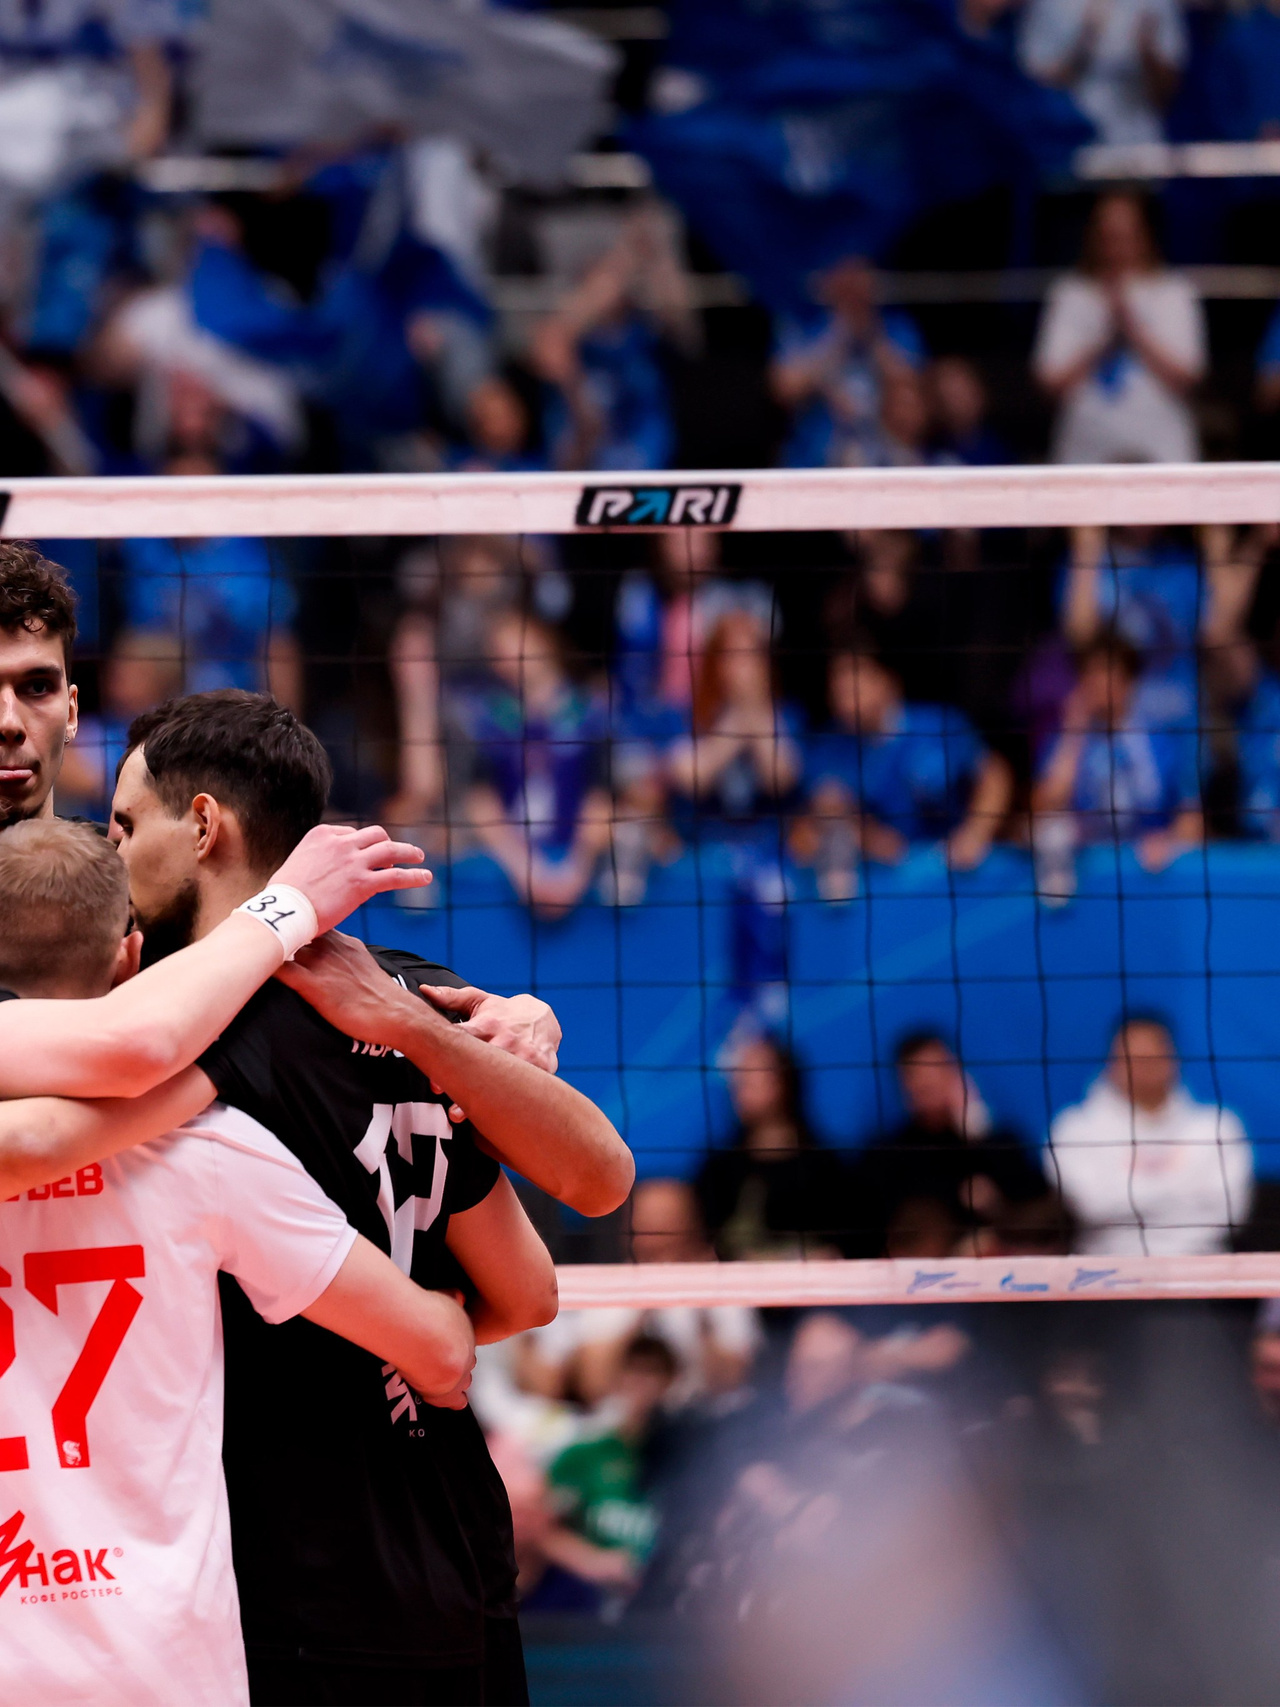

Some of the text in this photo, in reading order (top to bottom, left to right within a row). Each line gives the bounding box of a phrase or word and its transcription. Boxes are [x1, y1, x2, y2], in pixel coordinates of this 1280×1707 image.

[587, 488, 730, 524] PARI
[247, 895, 296, 932] 31
[20, 1586, 124, 1605] КОФЕ РОСТЕРС
